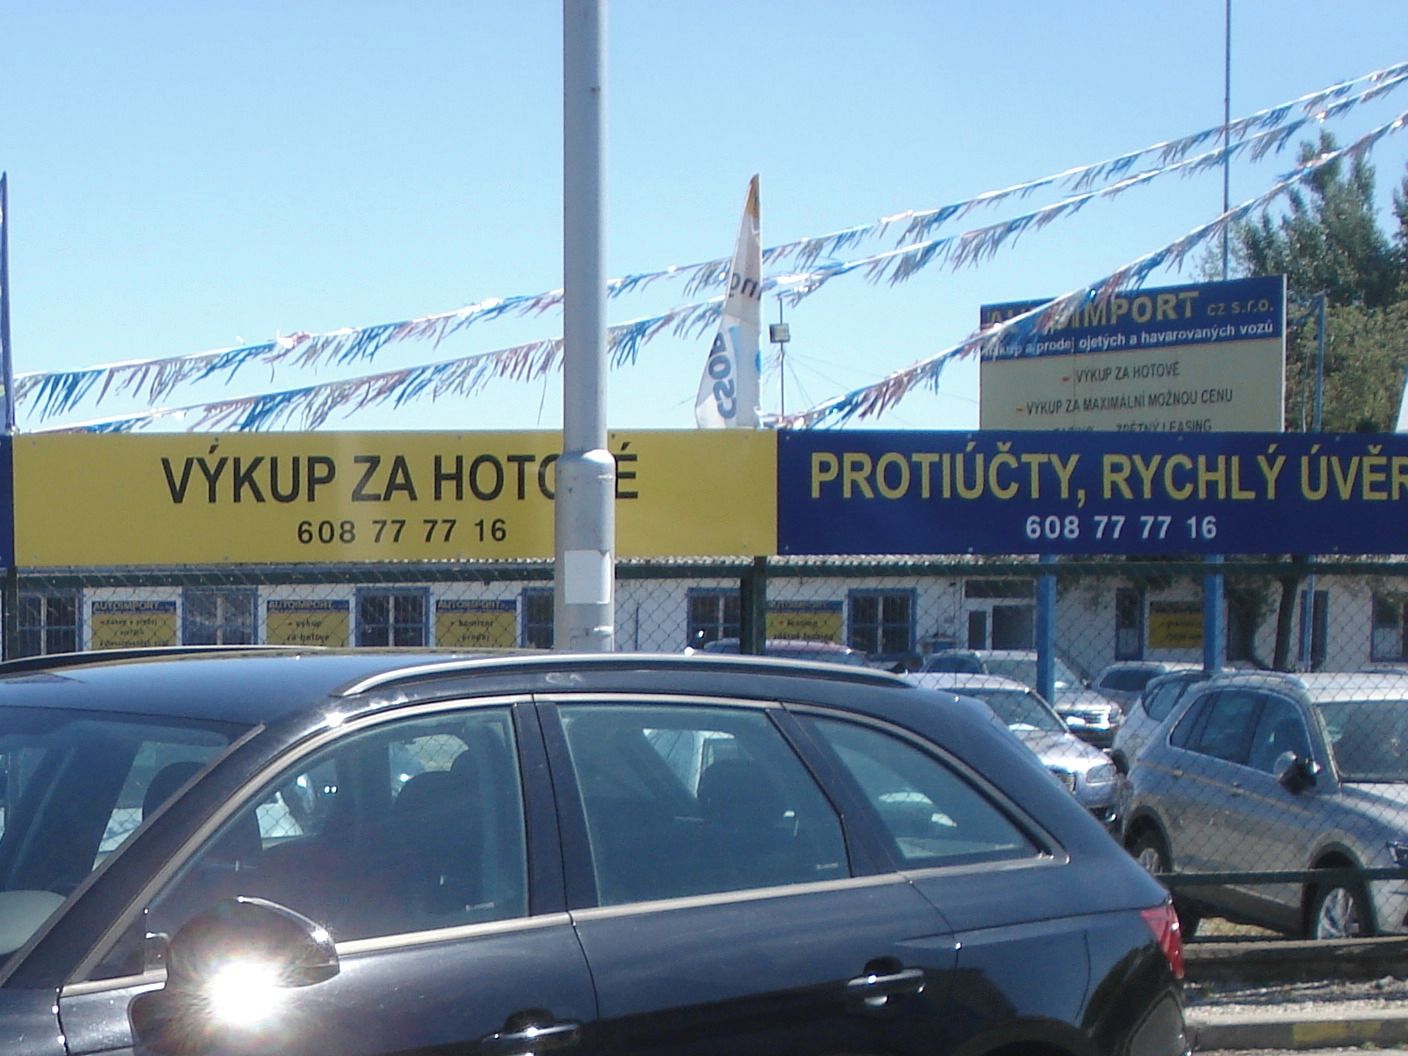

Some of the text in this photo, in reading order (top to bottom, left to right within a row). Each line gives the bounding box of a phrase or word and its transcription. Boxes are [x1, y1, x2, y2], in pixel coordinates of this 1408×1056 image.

[985, 290, 1200, 337] IMPORT
[1207, 303, 1225, 316] cz
[1036, 337, 1075, 355] prodej
[1079, 333, 1126, 351] ojetých
[1129, 334, 1138, 345] a
[1141, 324, 1236, 344] havarovaných
[1115, 366, 1130, 380] ZA
[1065, 399, 1080, 414] ZA
[1201, 387, 1233, 404] CENU
[161, 441, 639, 504] VÝKUP ZA HOTOÉ
[811, 440, 1085, 508] PROTIÚČTY,
[1102, 443, 1286, 500] RYCHLÝ
[297, 519, 507, 545] 608 77 77 16
[1025, 515, 1217, 540] 608 77 77 16
